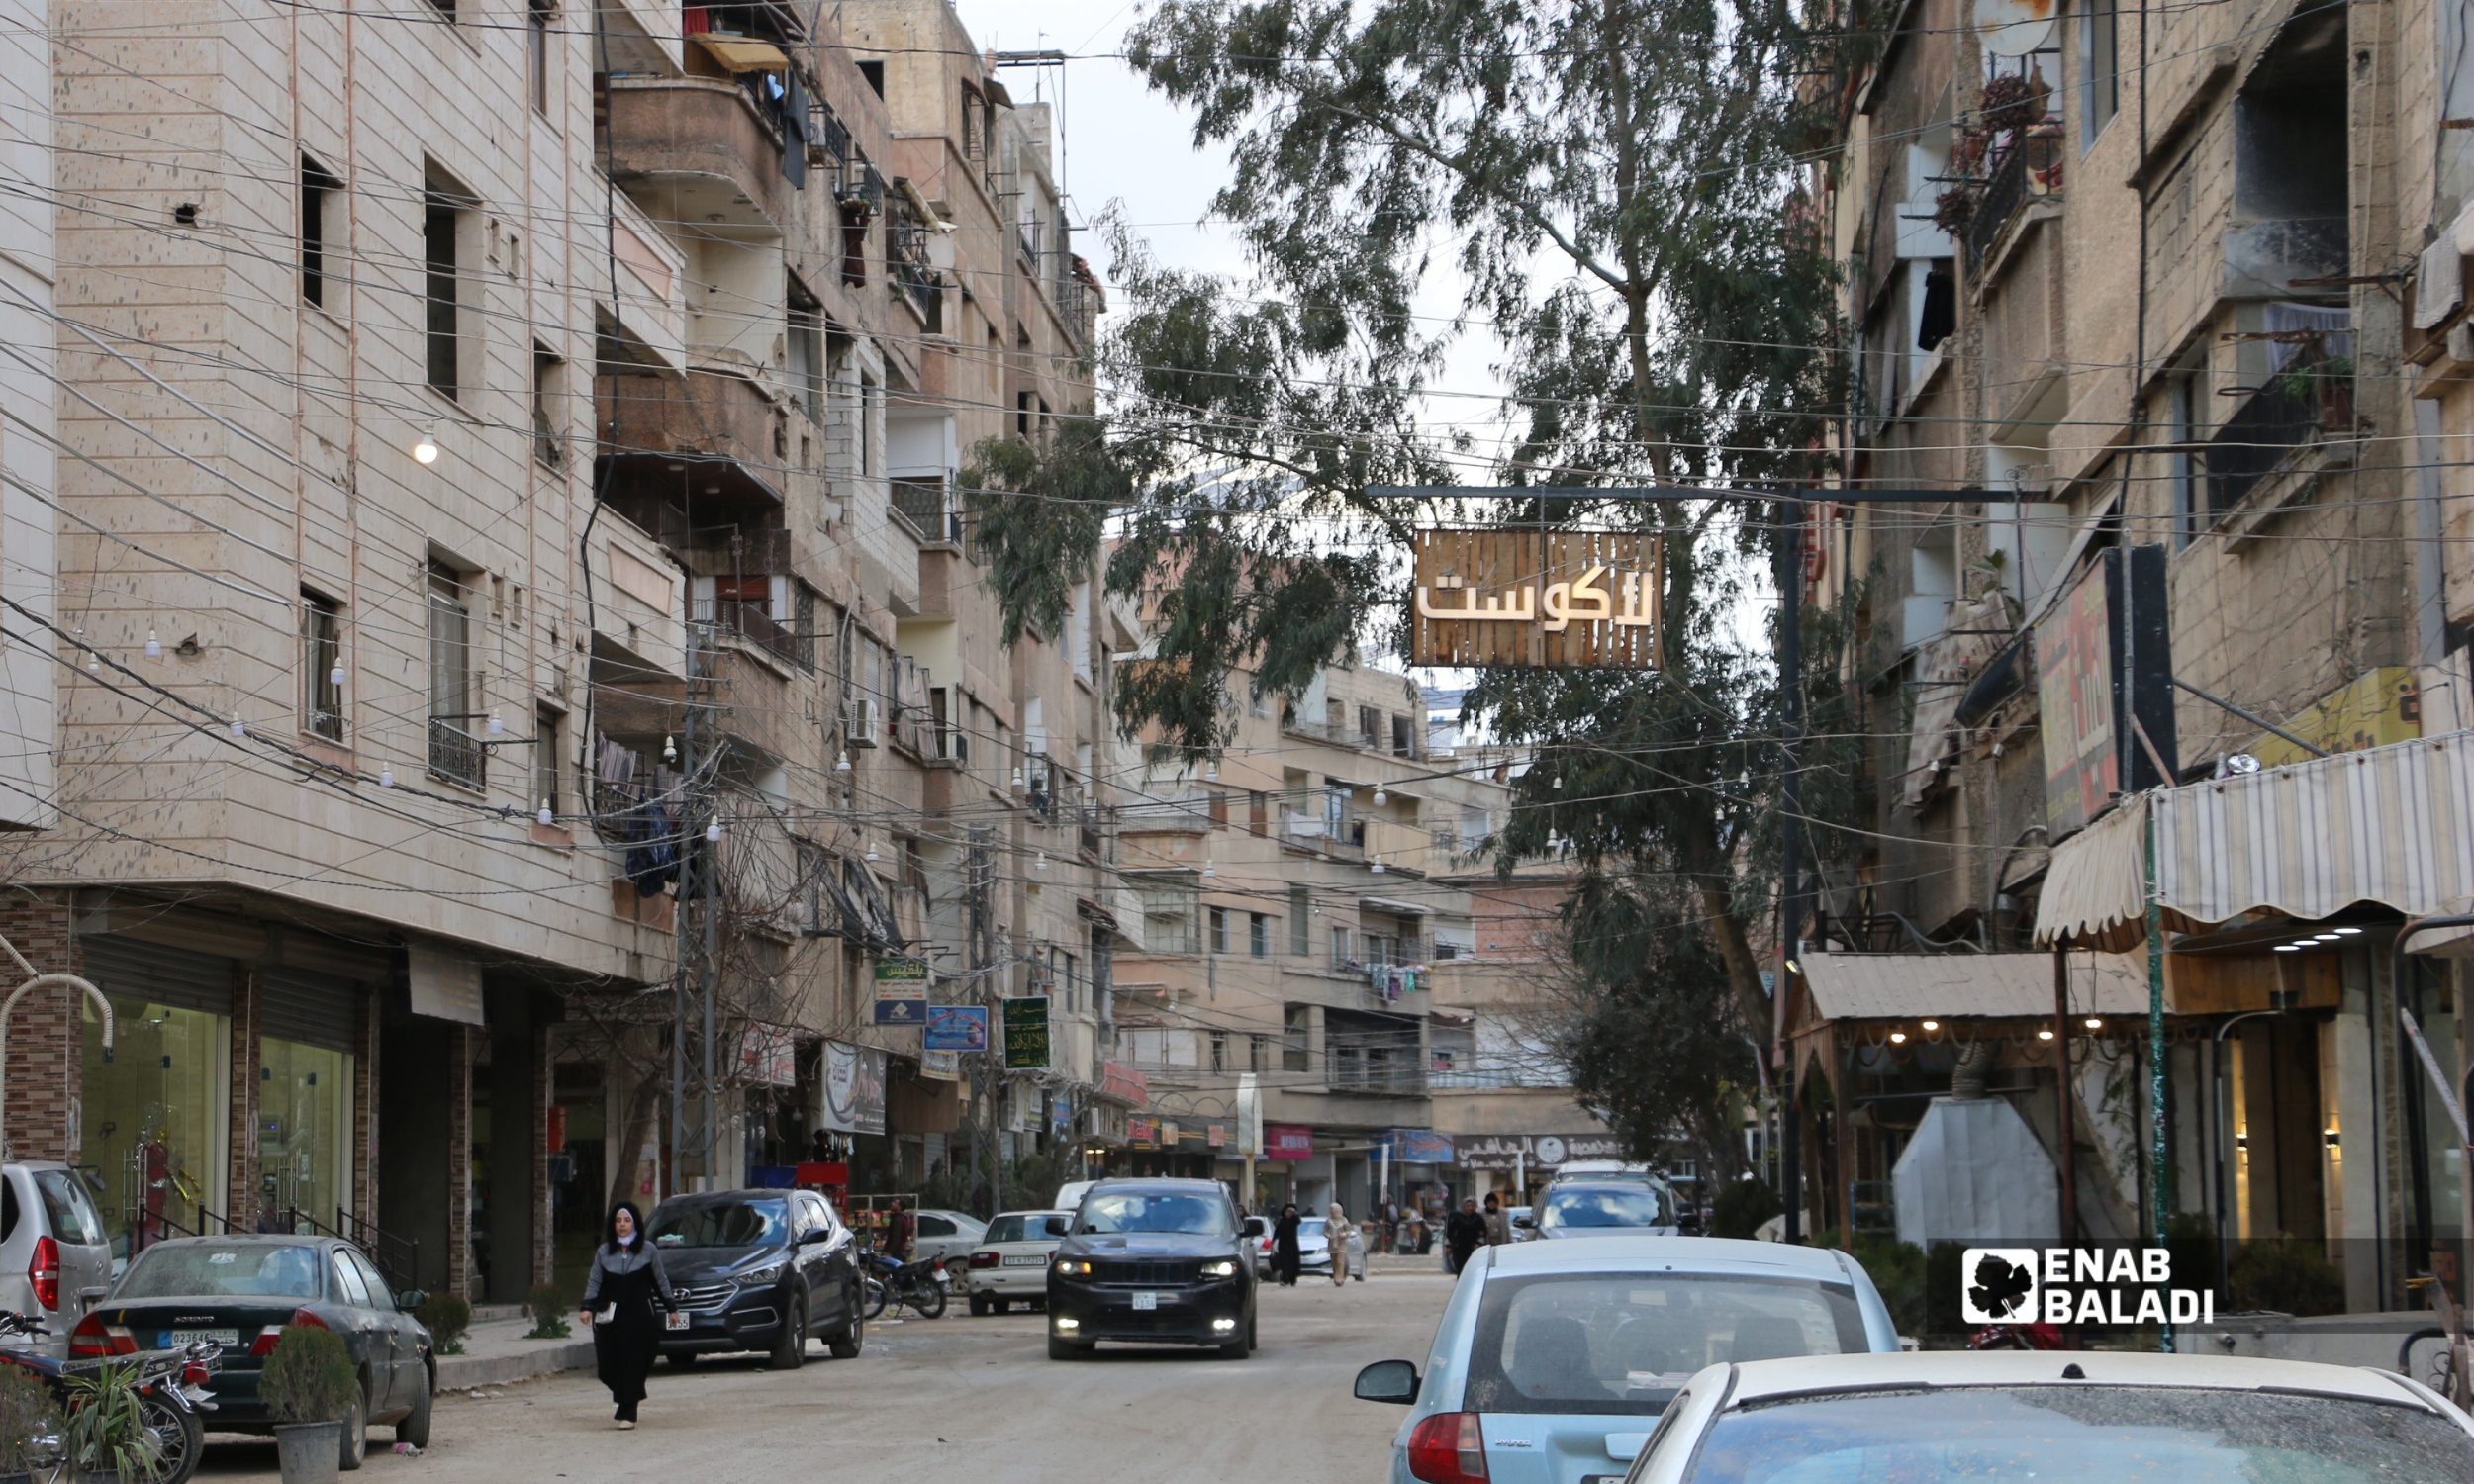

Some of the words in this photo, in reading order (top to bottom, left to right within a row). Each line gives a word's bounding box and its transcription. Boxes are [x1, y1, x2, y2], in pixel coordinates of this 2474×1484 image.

[1417, 565, 1653, 632] لاكوست
[887, 963, 923, 977] بلقيس
[1458, 1136, 1534, 1160] الهاشمي
[173, 1334, 210, 1344] 023646
